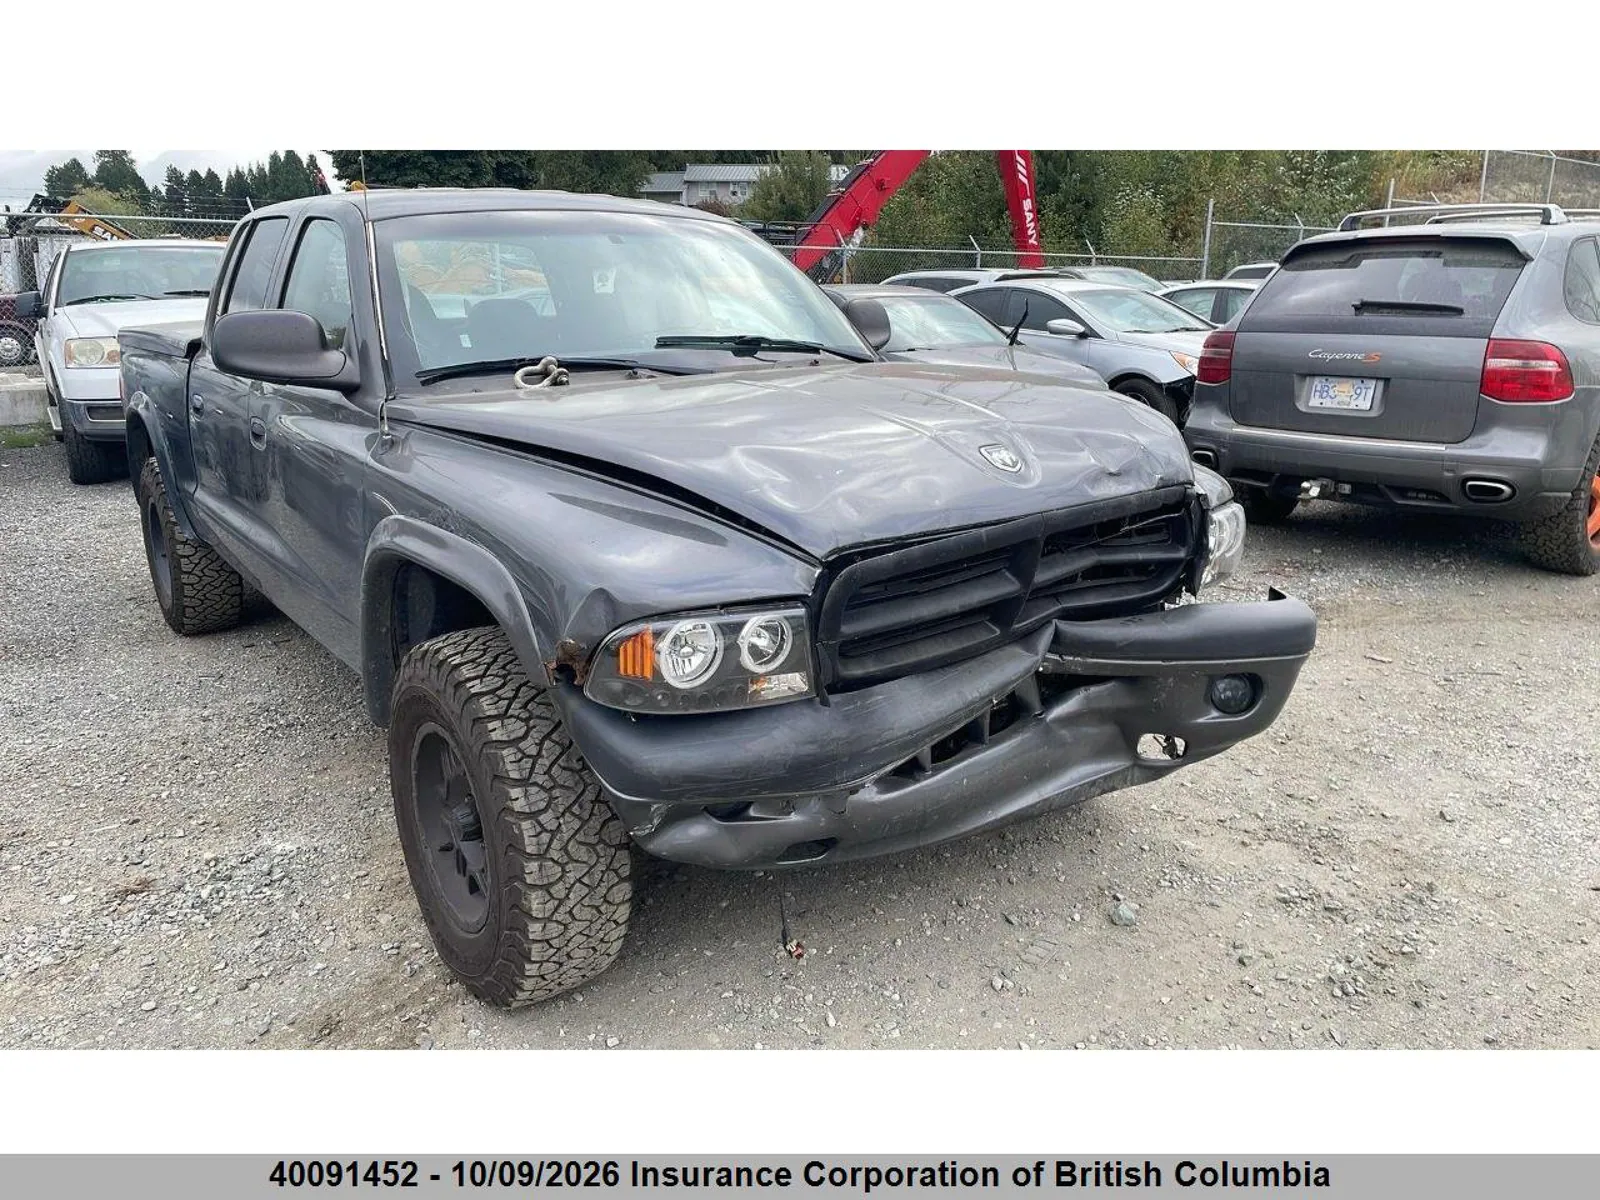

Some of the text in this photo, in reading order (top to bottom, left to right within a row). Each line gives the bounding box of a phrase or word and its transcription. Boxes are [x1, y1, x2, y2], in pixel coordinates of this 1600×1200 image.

[1022, 199, 1038, 246] SANY
[1308, 348, 1382, 363] Cayenne S
